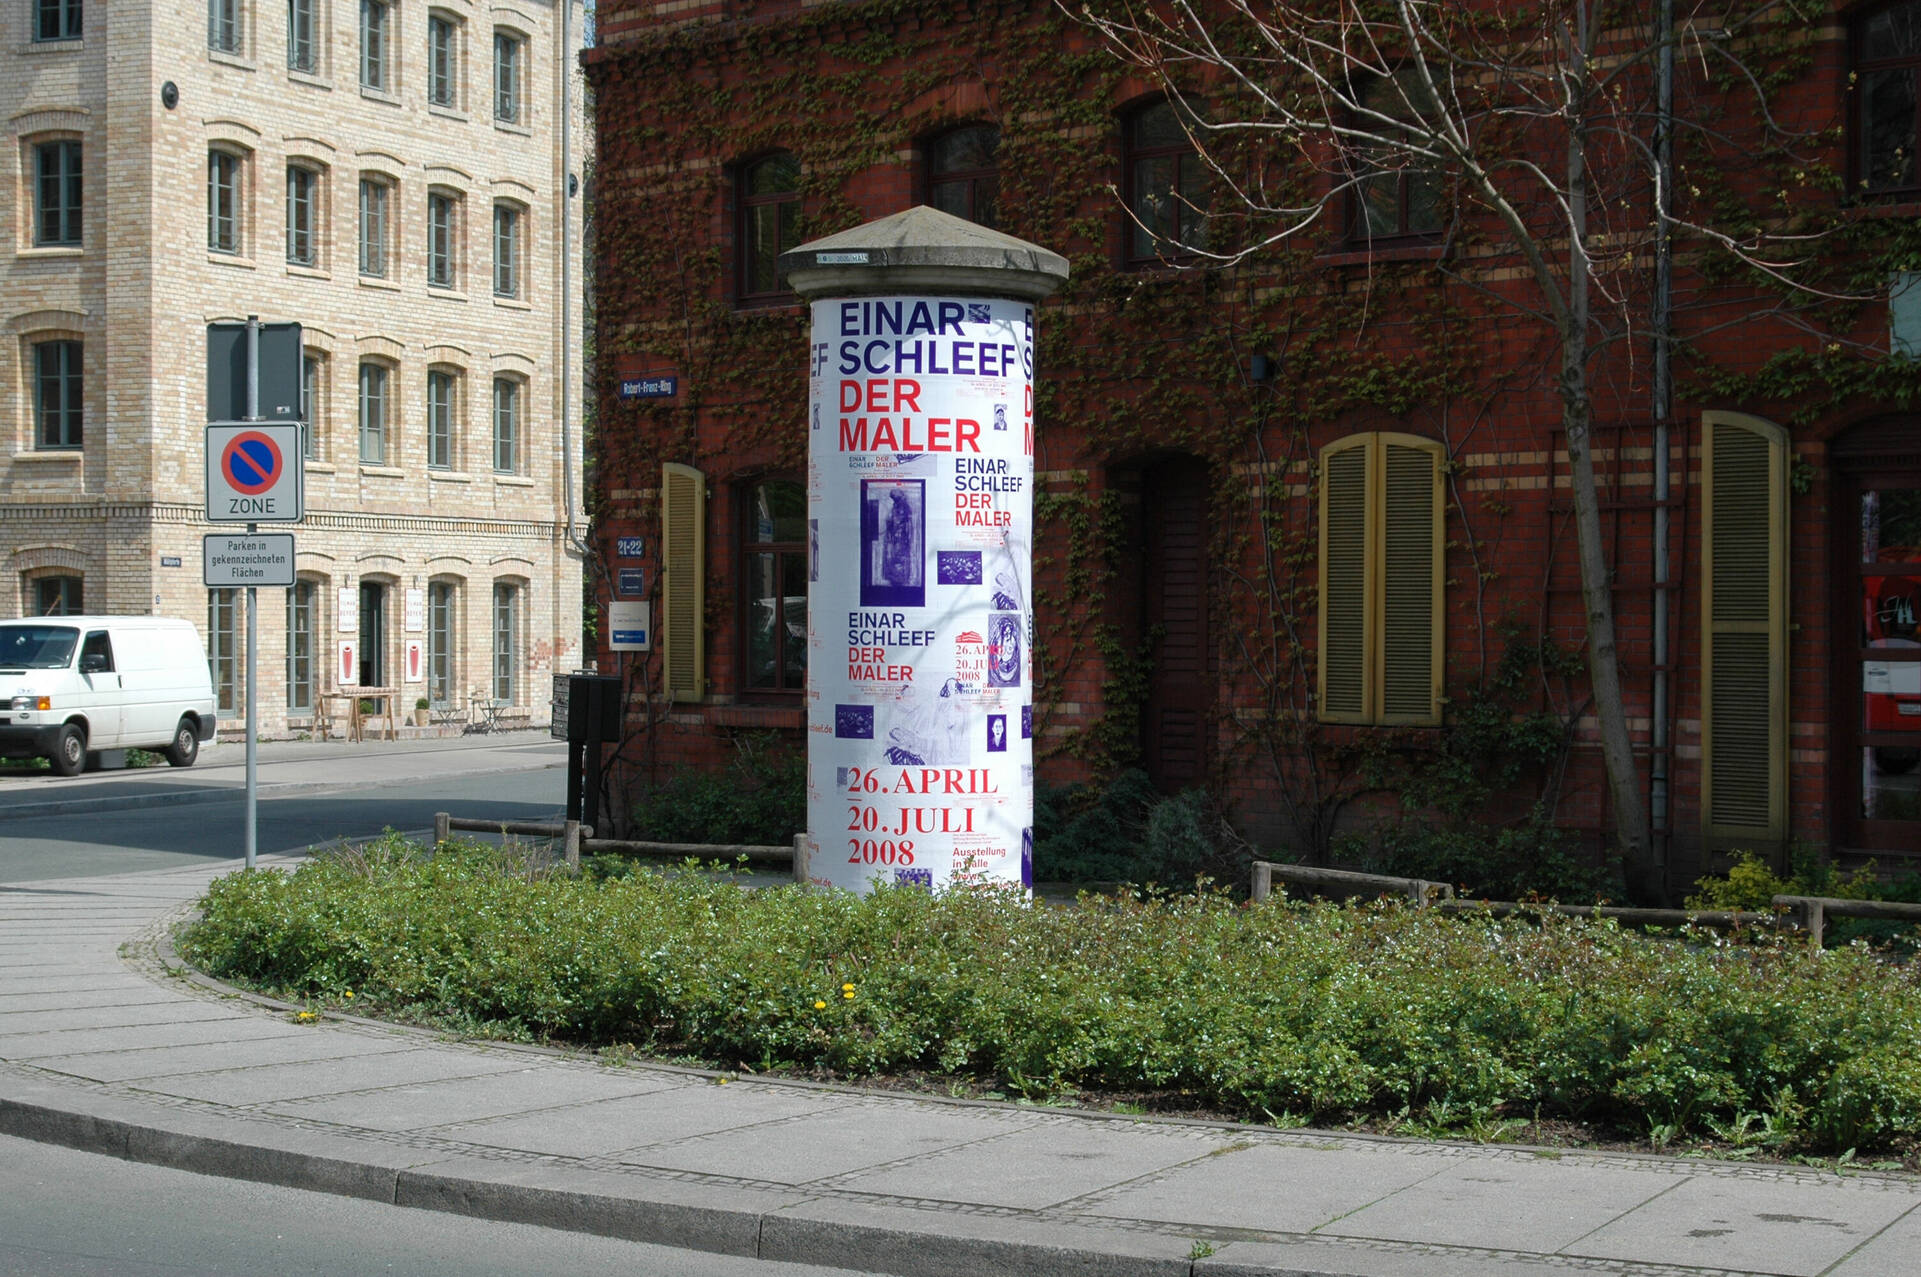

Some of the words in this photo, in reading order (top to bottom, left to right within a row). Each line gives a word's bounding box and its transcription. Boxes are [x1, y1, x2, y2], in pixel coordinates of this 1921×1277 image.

[841, 301, 966, 336] EINAR
[838, 340, 1015, 377] SCHLEEF
[839, 378, 921, 413] DER
[839, 417, 981, 453] MALER
[955, 458, 1007, 475] EINAR
[954, 476, 1023, 492] SCHLEEF
[229, 498, 276, 514] ZONE
[955, 493, 991, 509] DER
[955, 511, 1011, 527] MALER
[228, 540, 257, 550] Parken
[258, 540, 267, 550] in
[617, 540, 642, 555] 21-22
[211, 554, 286, 566] gekennzeichneten
[231, 567, 264, 577] Flächen
[849, 612, 905, 629] EINAR
[848, 630, 935, 647] SCHLEEF
[848, 647, 885, 663] DER
[848, 665, 913, 681] MALER
[955, 671, 980, 681] 2008
[847, 838, 915, 866] 2008
[952, 847, 1006, 857] Ausstellung
[952, 859, 962, 868] in
[963, 859, 988, 868] alle
